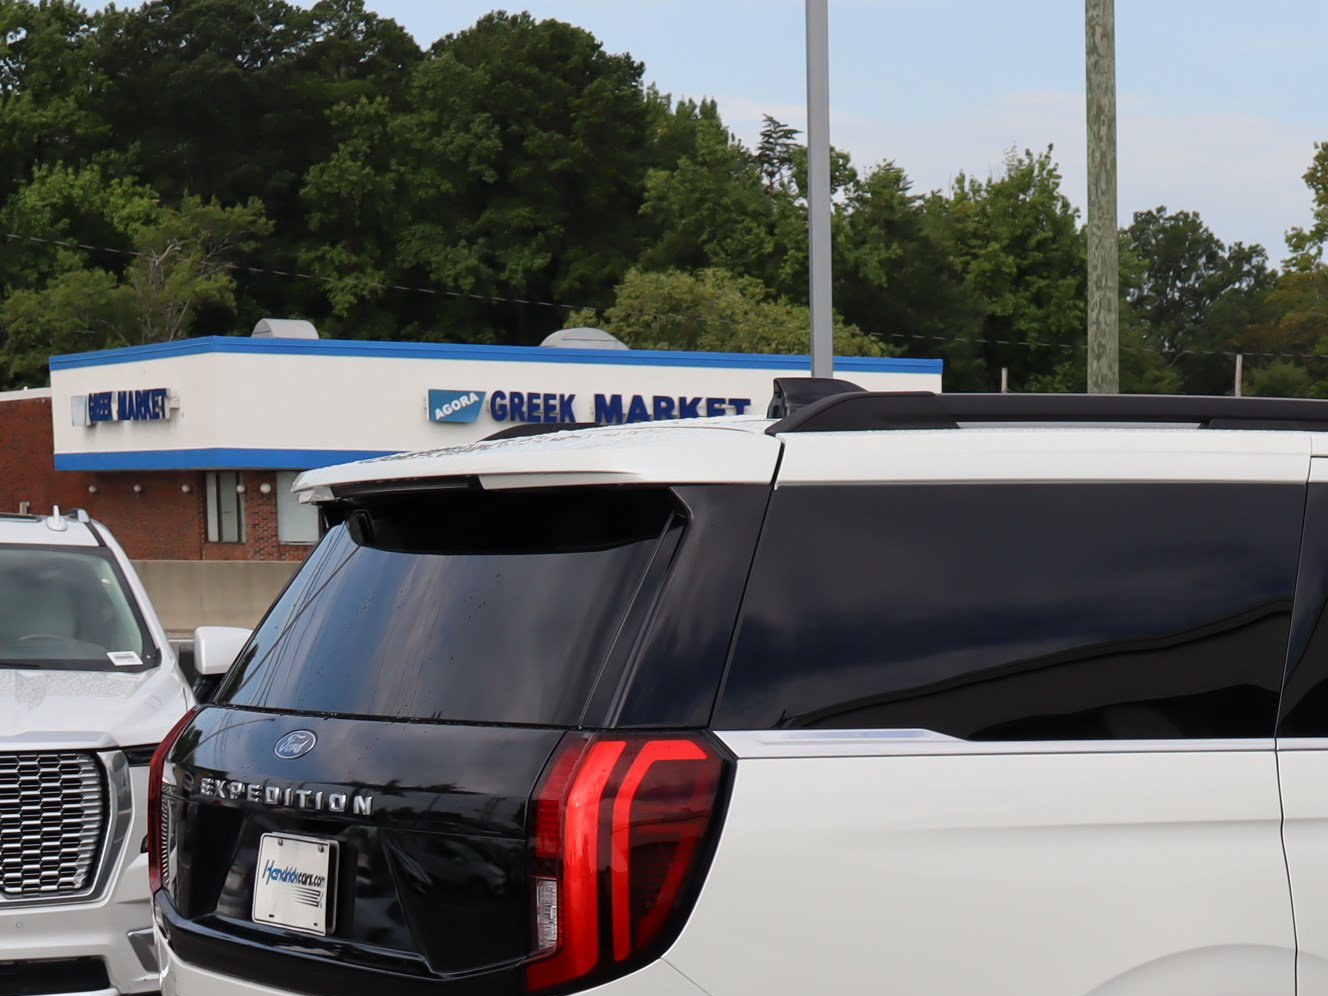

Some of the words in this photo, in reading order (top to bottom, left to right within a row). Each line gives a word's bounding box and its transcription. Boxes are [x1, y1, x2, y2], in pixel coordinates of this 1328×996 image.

[117, 388, 167, 421] MARKET
[435, 392, 480, 420] AGORA
[490, 390, 576, 423] GREEK
[594, 394, 751, 424] MARKET
[200, 777, 374, 816] EXPEDITION
